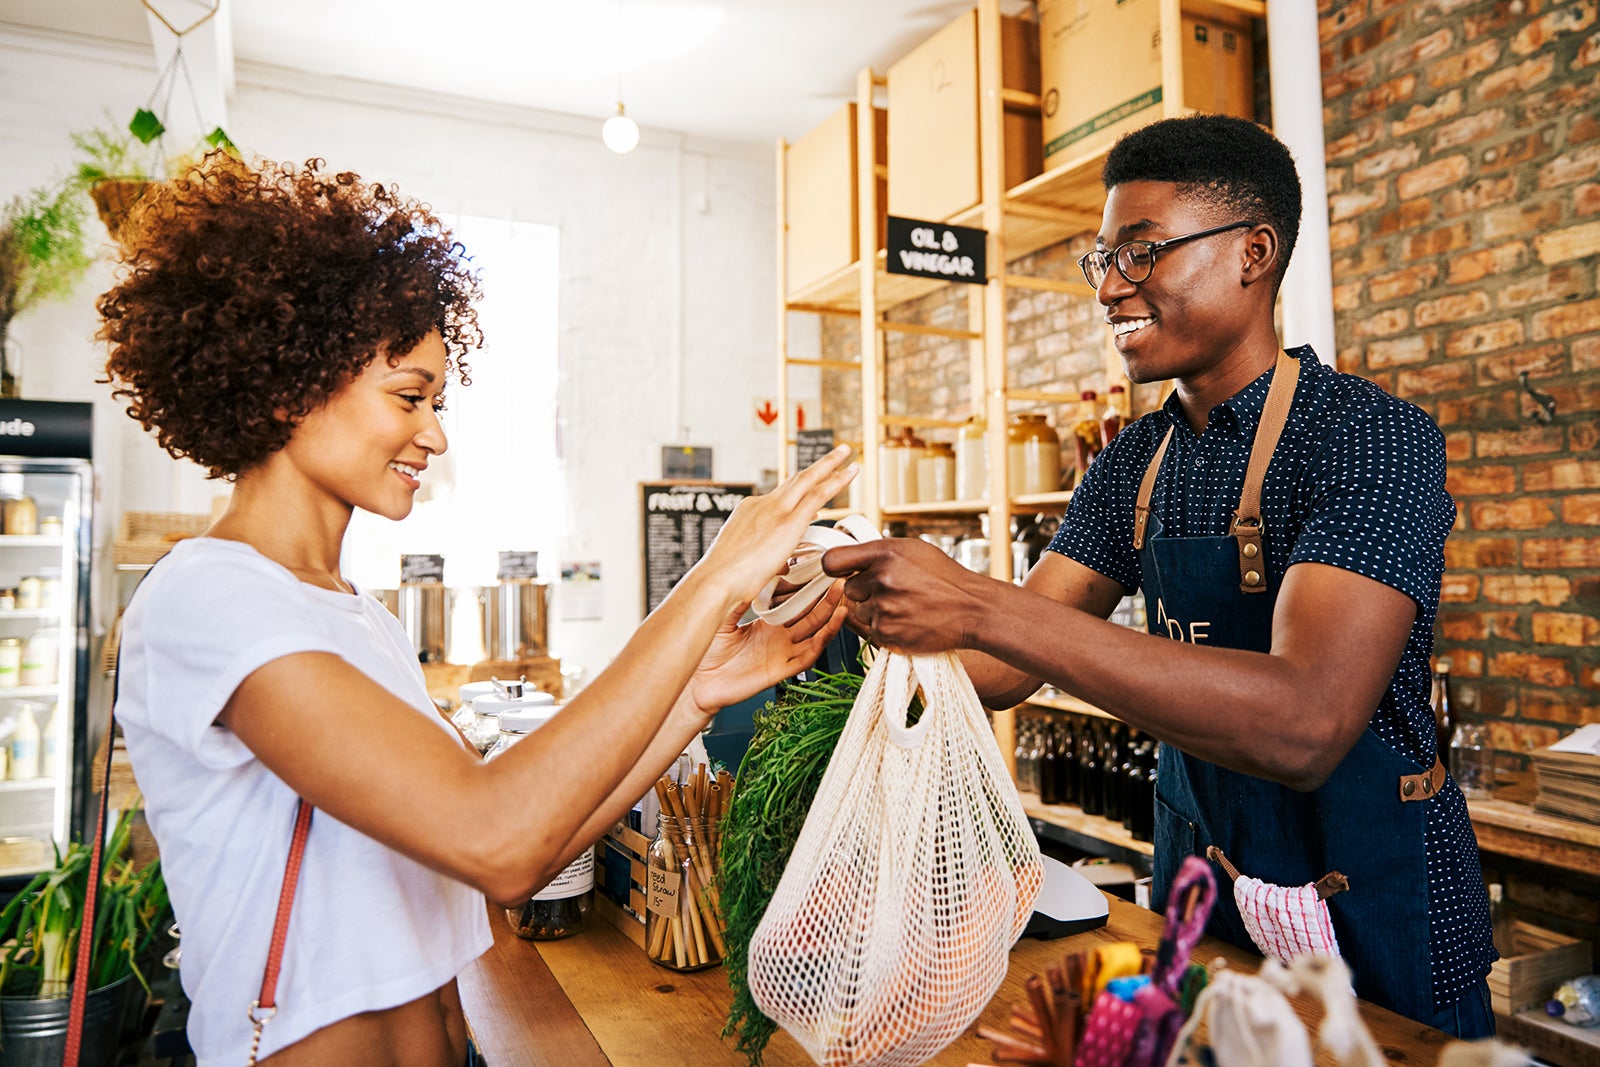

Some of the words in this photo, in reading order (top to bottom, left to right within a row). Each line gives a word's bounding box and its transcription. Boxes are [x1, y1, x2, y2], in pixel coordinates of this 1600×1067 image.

[911, 227, 940, 250] OIL
[941, 230, 959, 253] &
[899, 249, 975, 277] VINEGAR
[648, 492, 695, 512] FRUIT
[695, 492, 713, 512] &
